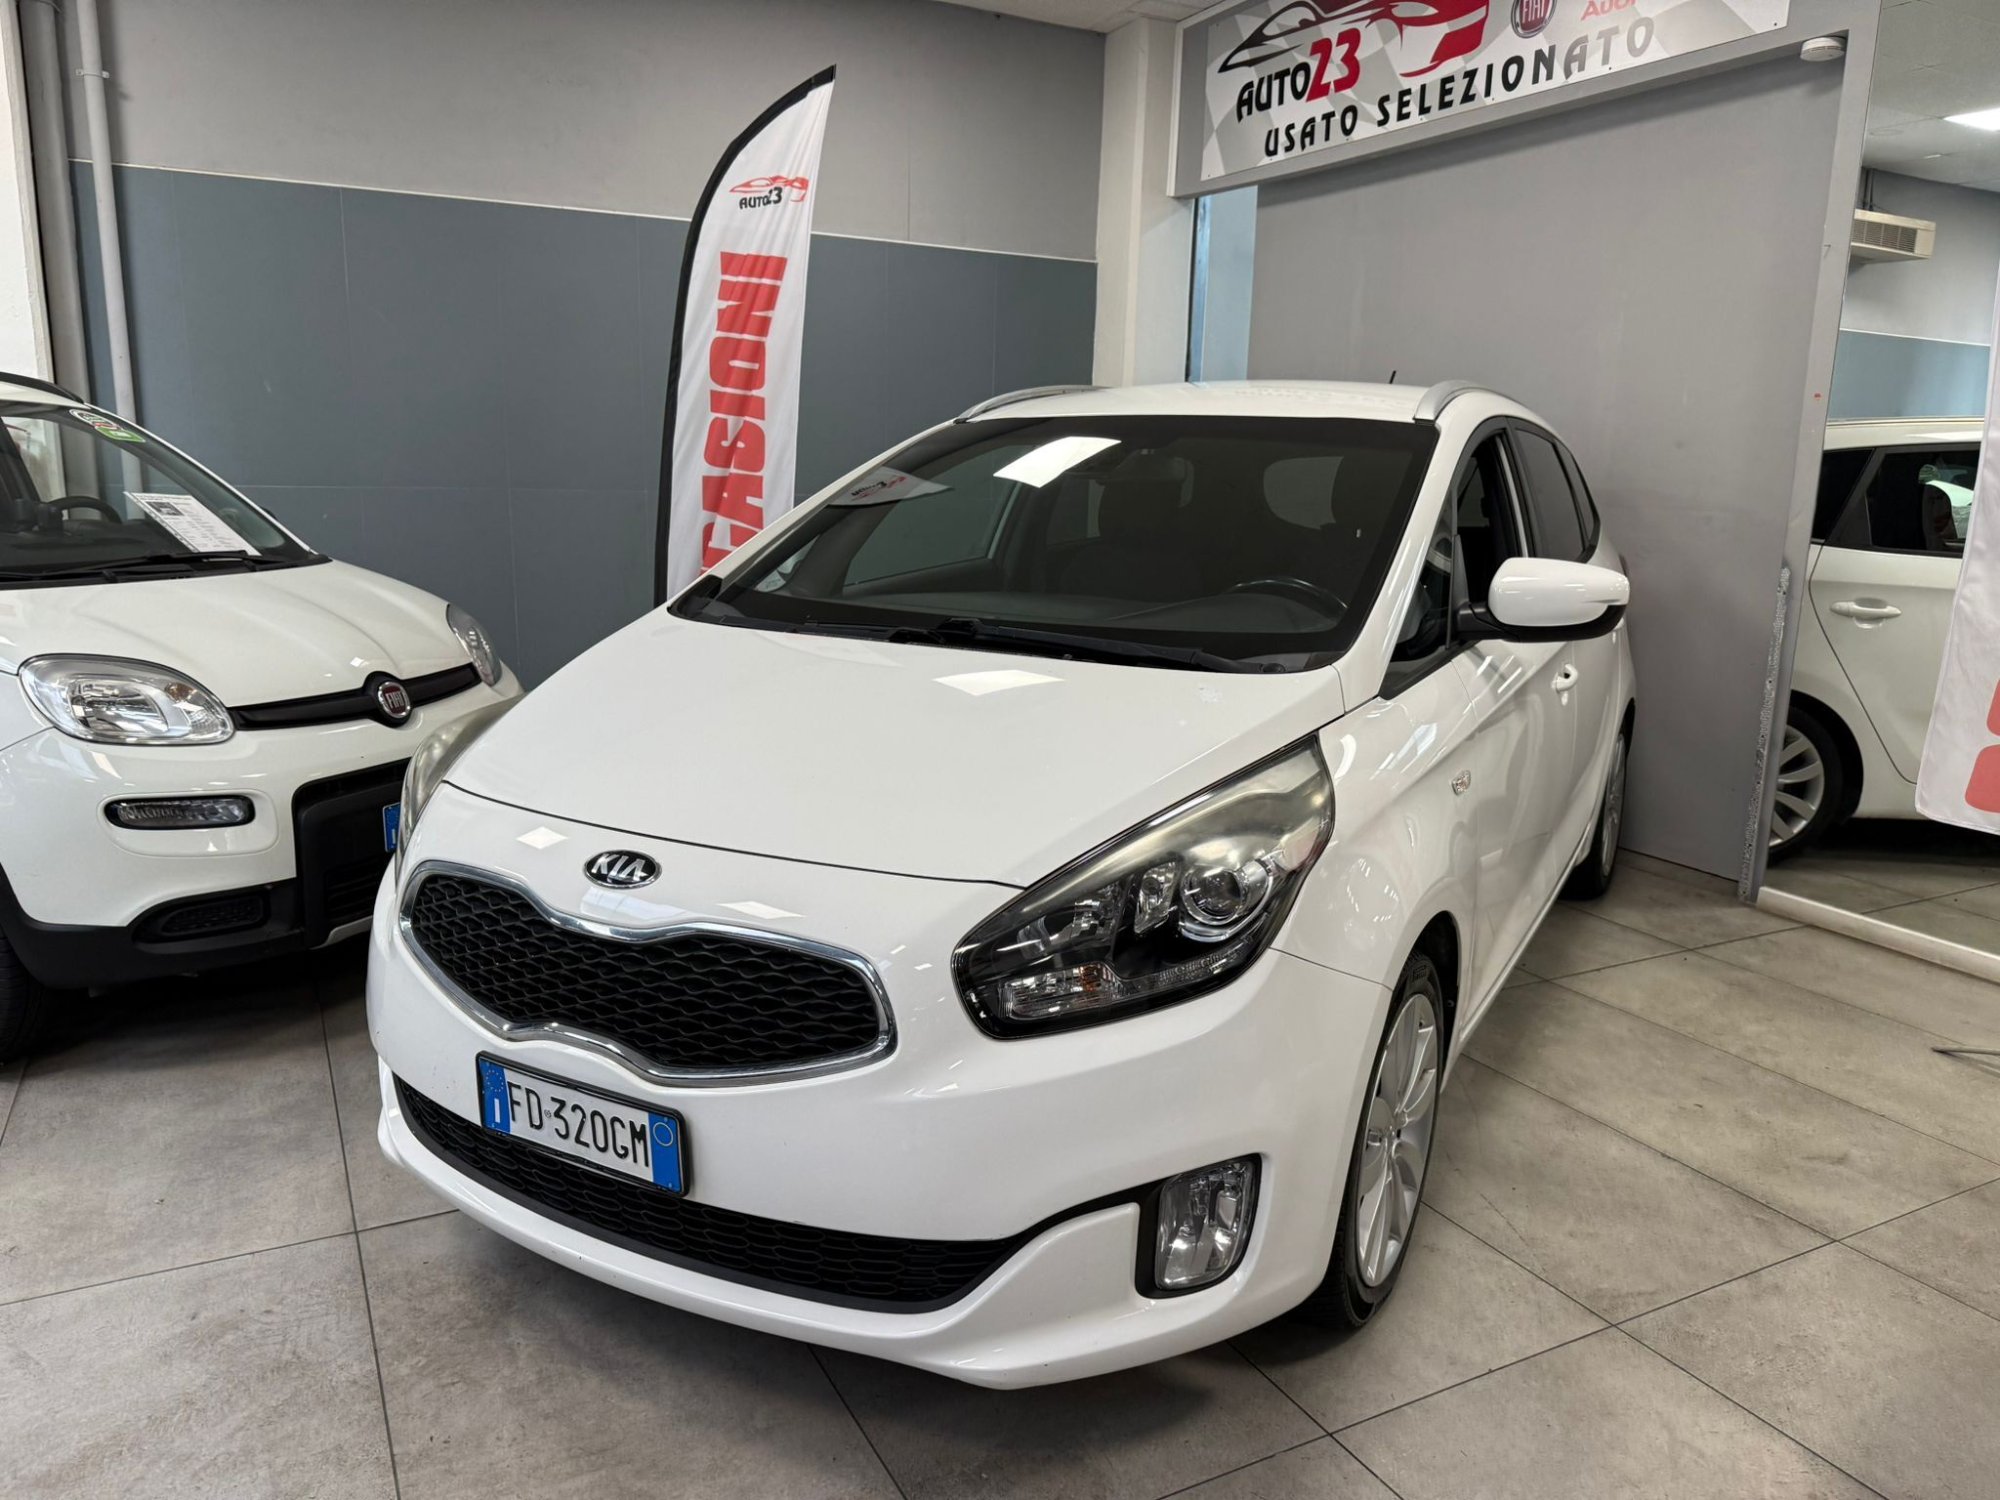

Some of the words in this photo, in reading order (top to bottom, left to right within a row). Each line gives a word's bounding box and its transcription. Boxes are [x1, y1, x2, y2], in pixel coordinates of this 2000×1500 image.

[1236, 27, 1361, 123] AUTO23
[1264, 104, 1358, 157] USATO
[1376, 16, 1654, 127] SELEZIONATO
[591, 853, 649, 882] KIA
